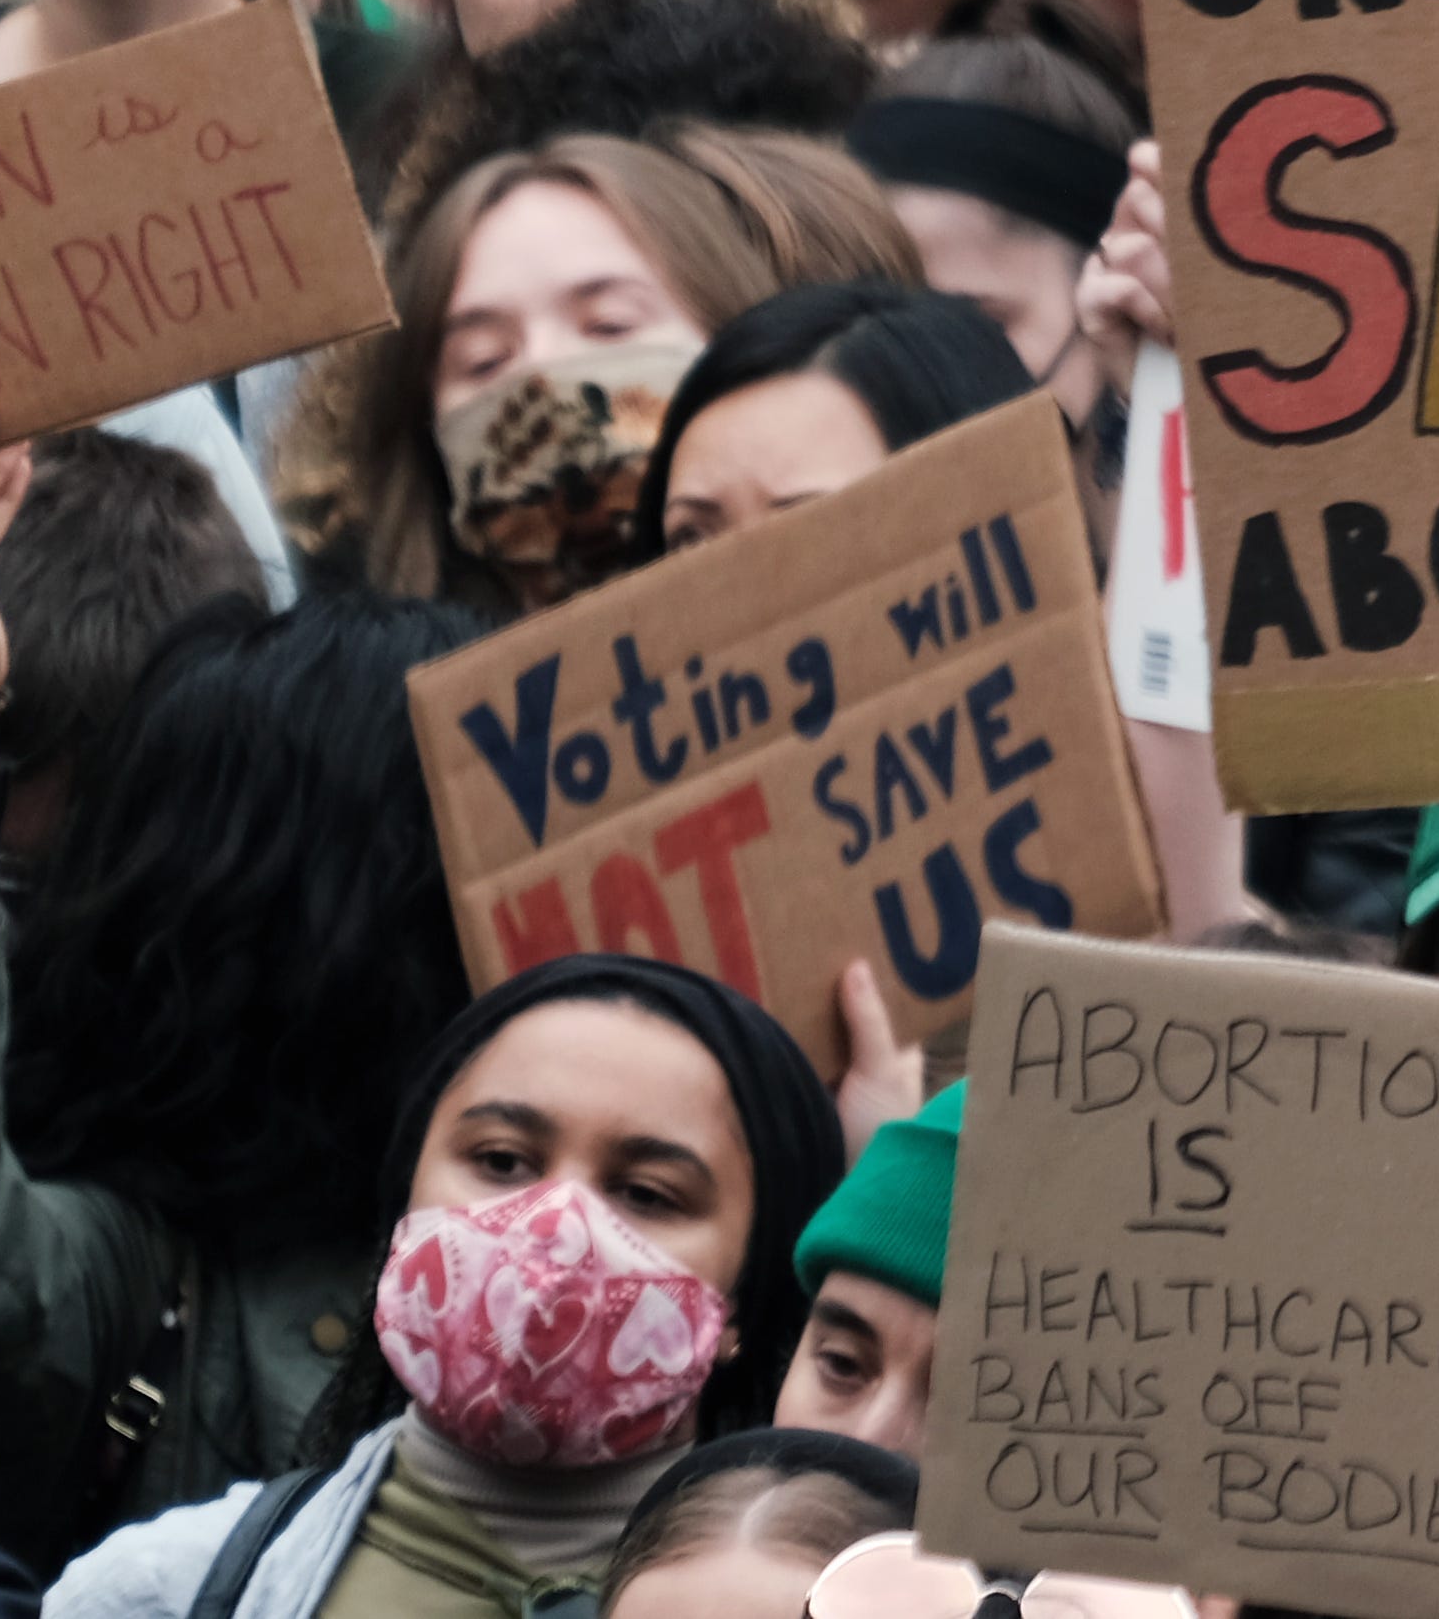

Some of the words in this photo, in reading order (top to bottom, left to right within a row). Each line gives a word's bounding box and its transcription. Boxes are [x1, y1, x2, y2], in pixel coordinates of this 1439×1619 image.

[84, 94, 179, 149] is
[195, 119, 262, 164] a
[54, 183, 304, 358] RIGHT
[460, 635, 836, 850] Voting
[888, 512, 1037, 660] will
[814, 663, 1053, 866] SAVE
[873, 798, 1073, 1002] US
[1146, 1119, 1233, 1216] IS
[968, 1353, 1167, 1425] BANS
[1201, 1371, 1342, 1431] OFF
[984, 1439, 1161, 1523] OUR
